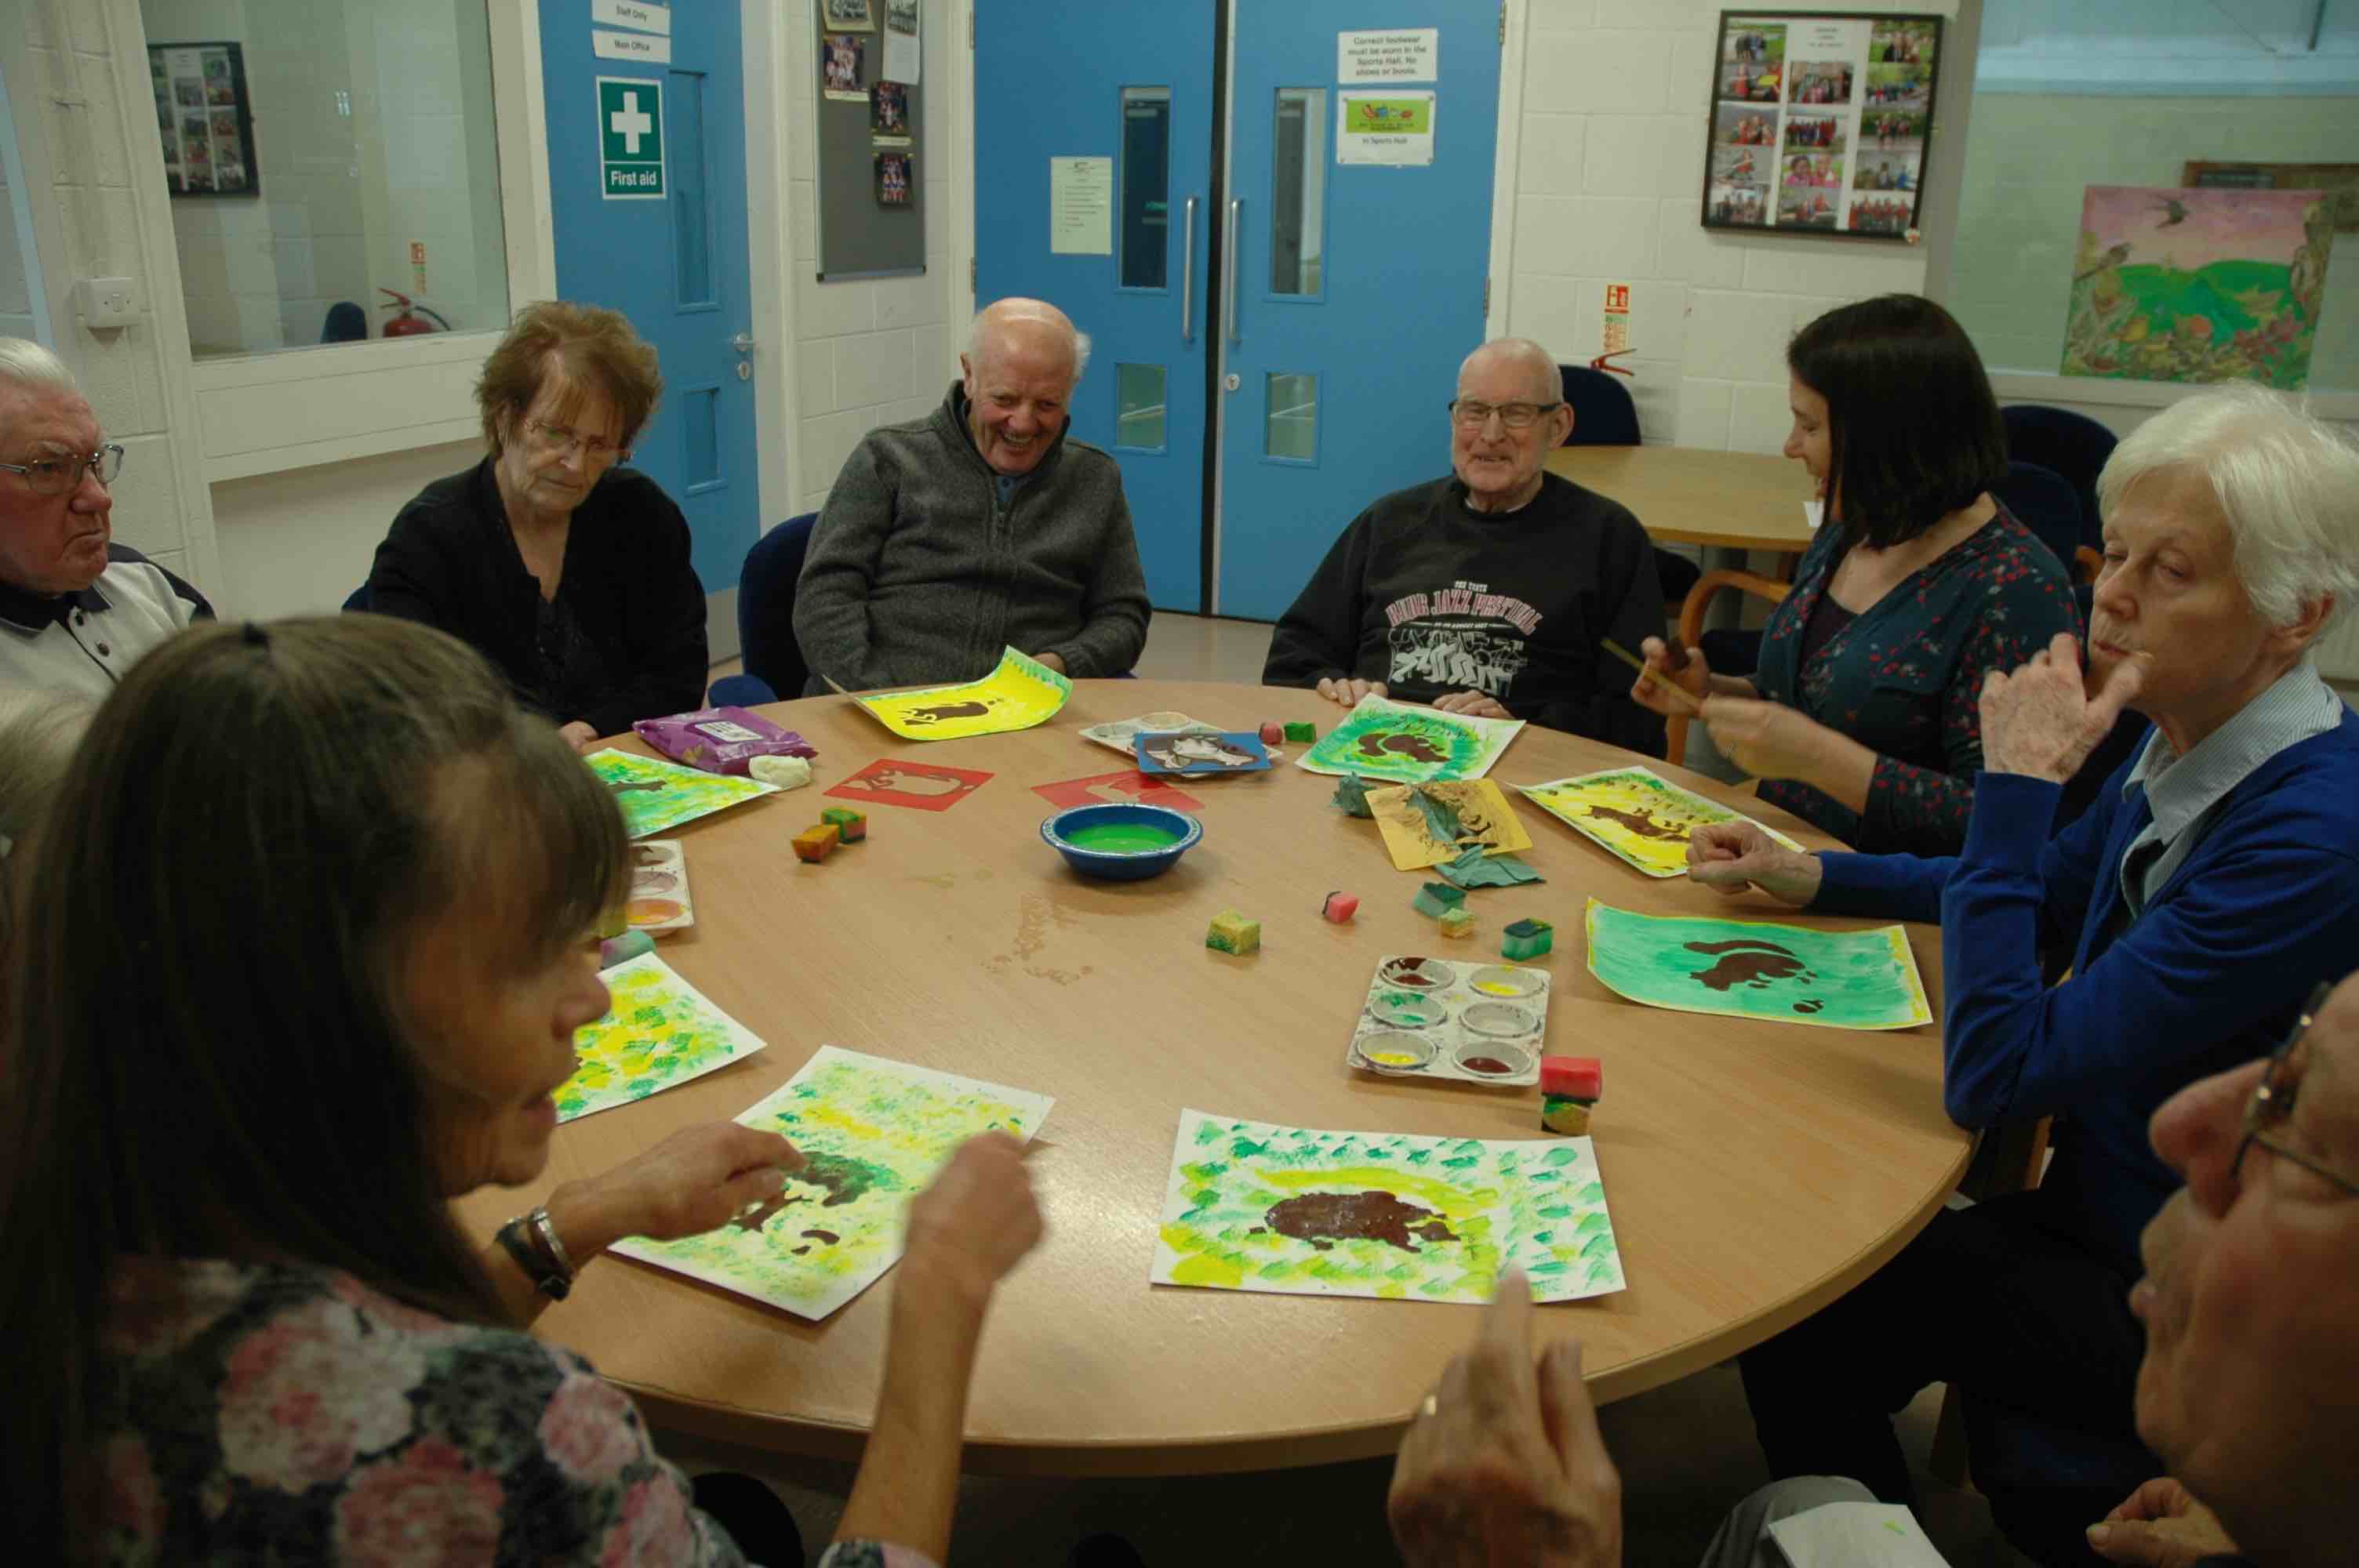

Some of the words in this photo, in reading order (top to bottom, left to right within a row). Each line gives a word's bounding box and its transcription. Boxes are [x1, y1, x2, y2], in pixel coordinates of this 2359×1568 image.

[1414, 45, 1427, 53] the
[1356, 56, 1383, 66] Sports
[611, 170, 637, 186] First
[640, 171, 657, 186] aid
[1430, 590, 1472, 615] JAZZ
[1470, 593, 1543, 636] FESTIVAL
